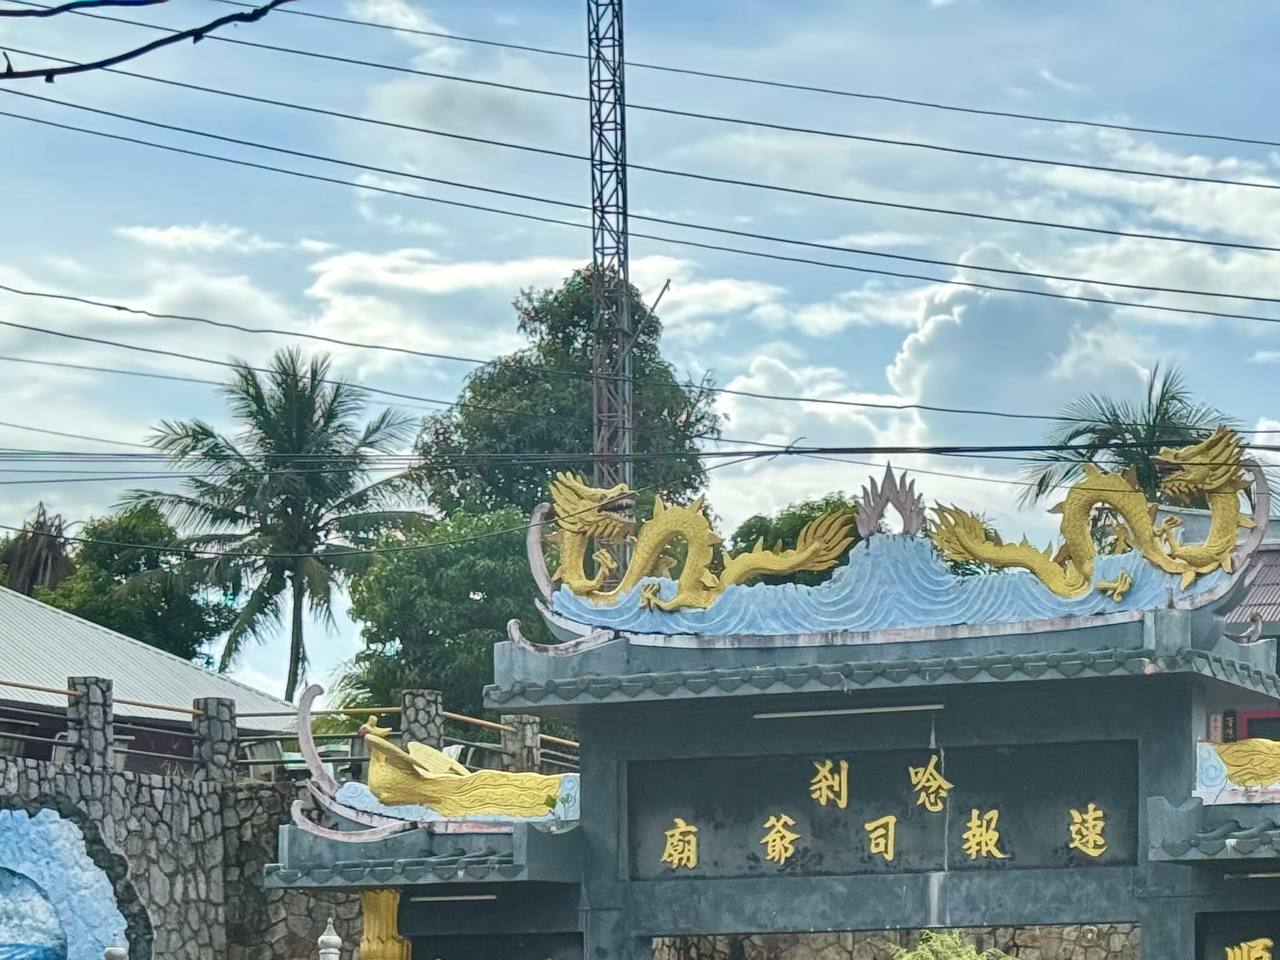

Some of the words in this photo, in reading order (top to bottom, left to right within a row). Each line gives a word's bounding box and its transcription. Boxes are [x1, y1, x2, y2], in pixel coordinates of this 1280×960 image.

[660, 803, 1109, 870] 速報司爺廟
